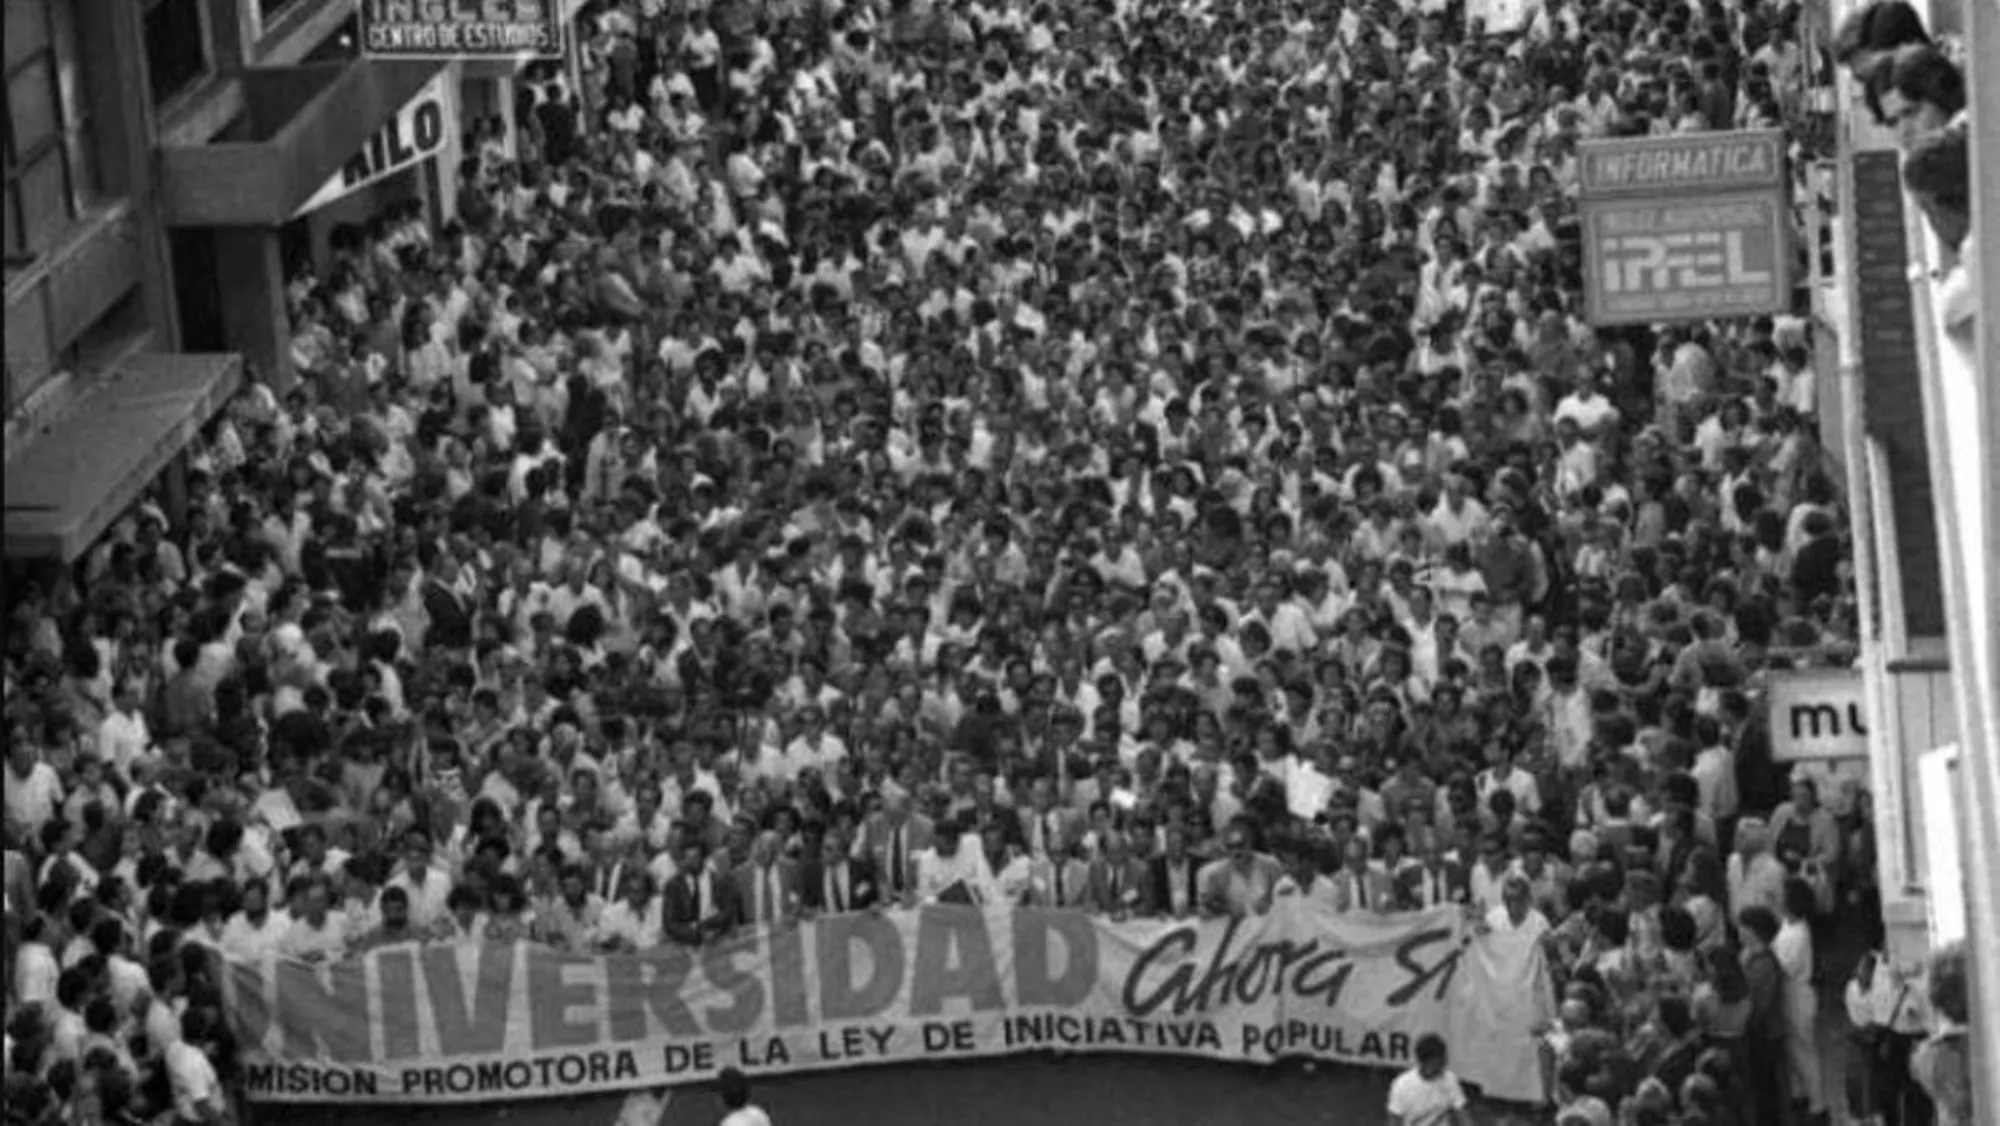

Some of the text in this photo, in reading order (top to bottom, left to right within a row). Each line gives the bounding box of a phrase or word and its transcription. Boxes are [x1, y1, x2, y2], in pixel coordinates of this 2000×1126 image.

[368, 22, 549, 48] CENTRO DE ESTUDIOS
[1597, 145, 1767, 182] INFORMATICA
[248, 1013, 1410, 1096] MISION PROMOTORA DE LA LEY DE INICIATIVA POPULAR
